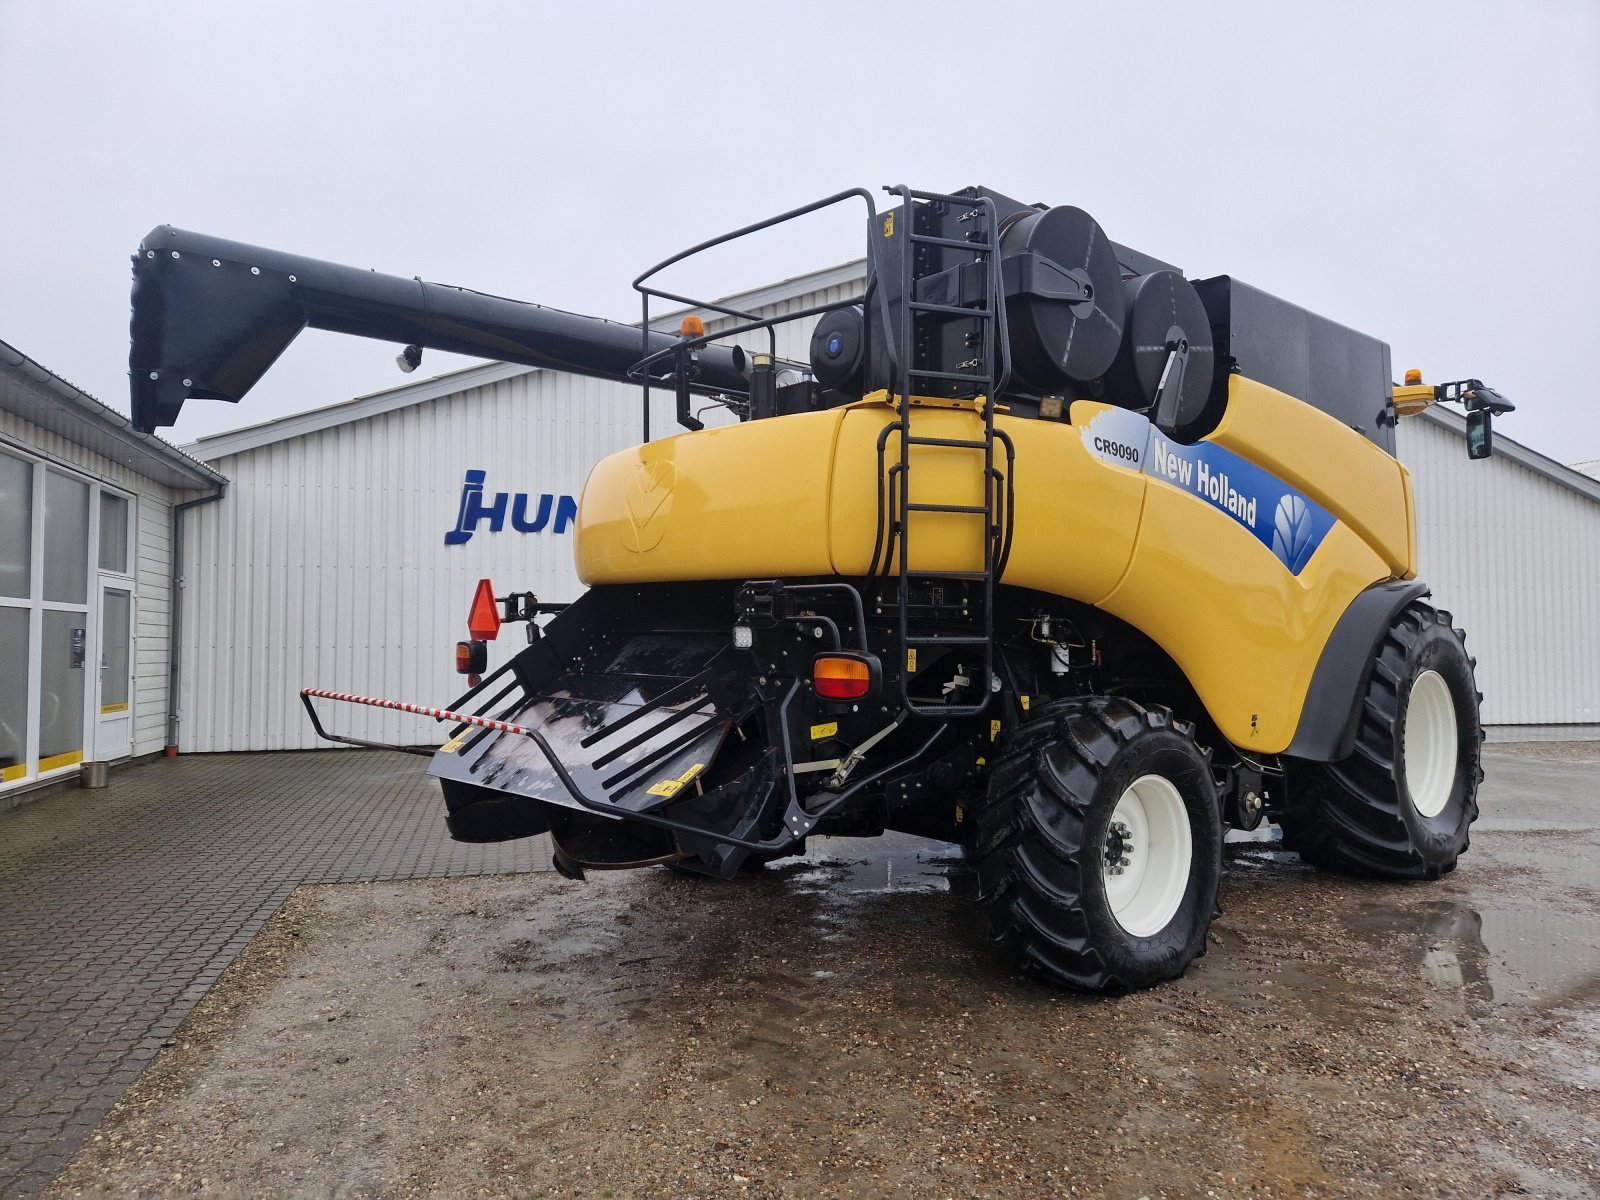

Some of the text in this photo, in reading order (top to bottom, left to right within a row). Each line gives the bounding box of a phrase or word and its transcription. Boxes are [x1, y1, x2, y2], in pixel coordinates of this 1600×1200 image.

[1094, 436, 1139, 463] CR9090
[1154, 437, 1257, 528] New Holland
